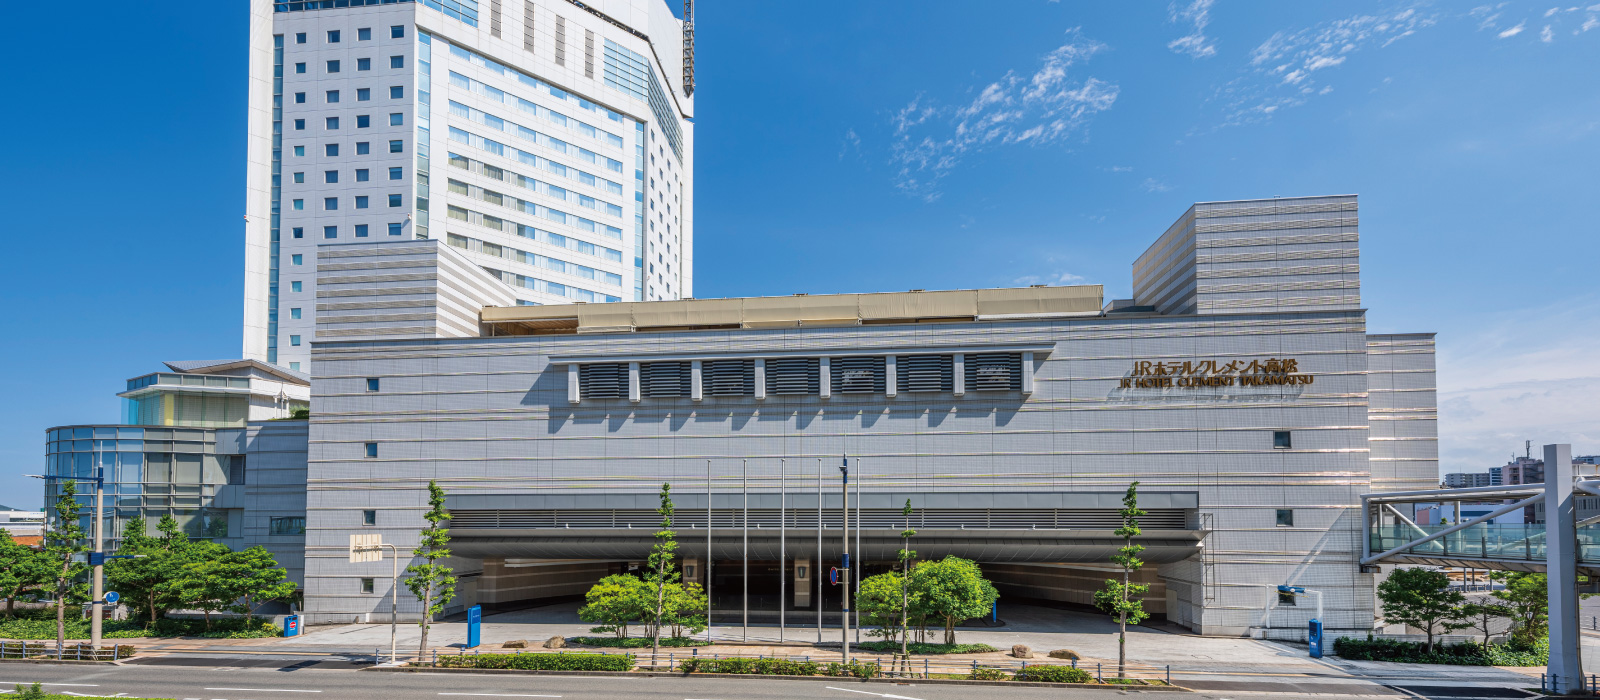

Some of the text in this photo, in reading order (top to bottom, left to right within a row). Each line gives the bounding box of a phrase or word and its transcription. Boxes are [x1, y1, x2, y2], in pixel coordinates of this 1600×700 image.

[1131, 358, 1299, 376] JRホテルクレメント高松
[1118, 375, 1314, 389] JR HOTEL CLEMENT TAKAMATSU
